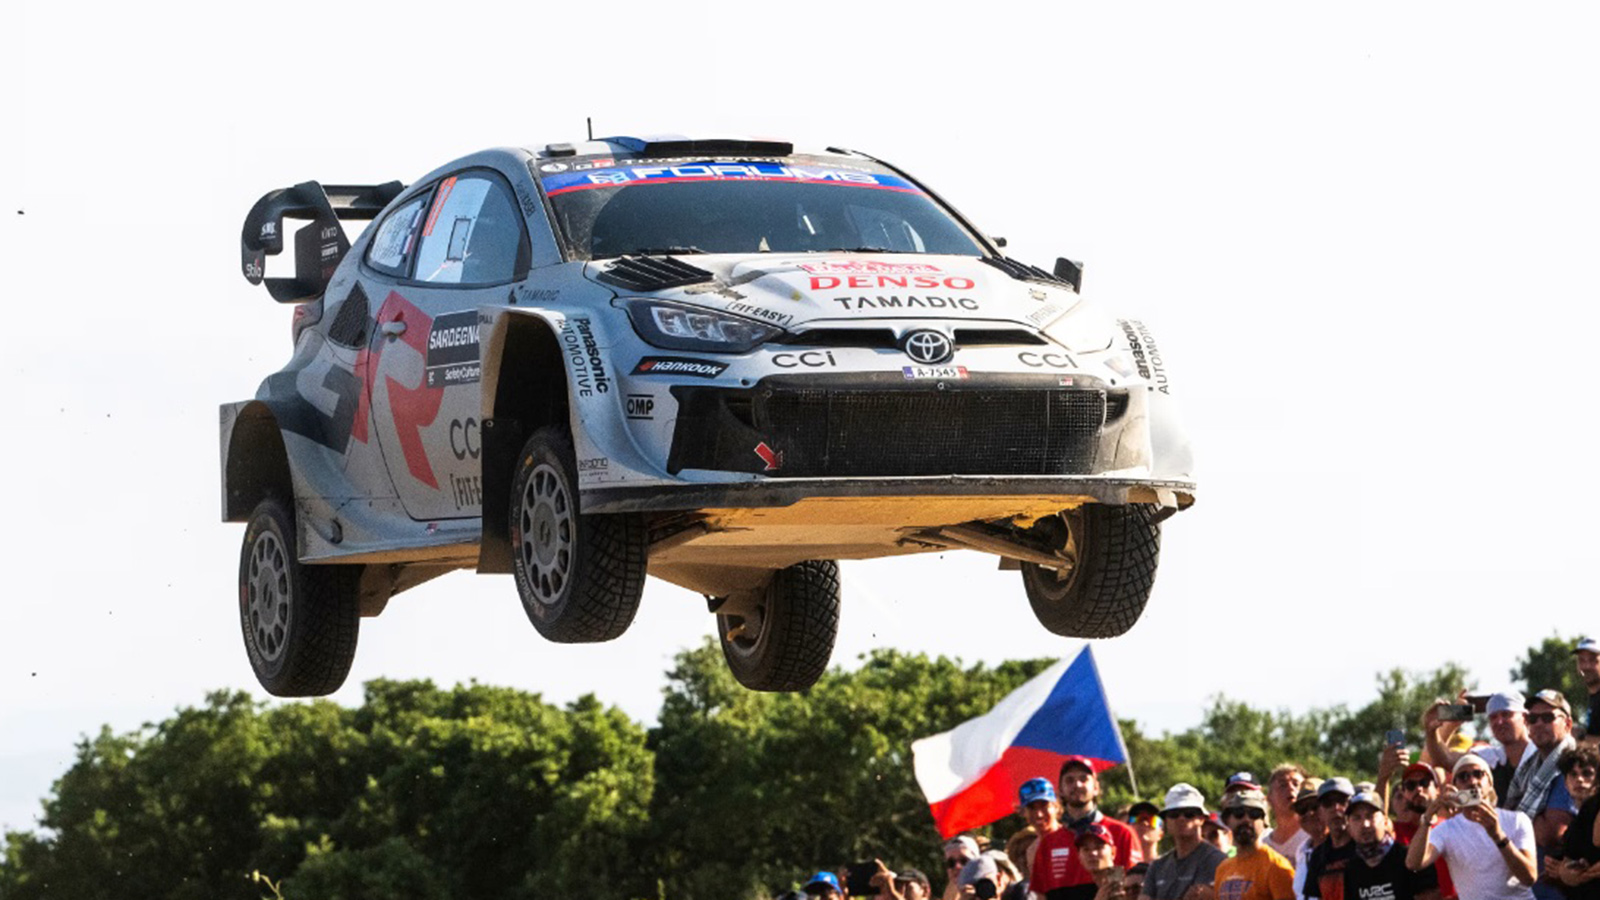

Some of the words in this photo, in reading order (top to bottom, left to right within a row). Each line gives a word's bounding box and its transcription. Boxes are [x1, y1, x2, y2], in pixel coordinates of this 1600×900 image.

[631, 165, 880, 185] FORUM8
[809, 275, 975, 290] DENSO
[833, 296, 979, 310] TAMADIC
[573, 318, 610, 393] Panasonic
[627, 398, 654, 415] OMP
[450, 417, 481, 460] CC
[449, 473, 482, 510] [FIT-E
[1358, 883, 1394, 898] WRC
